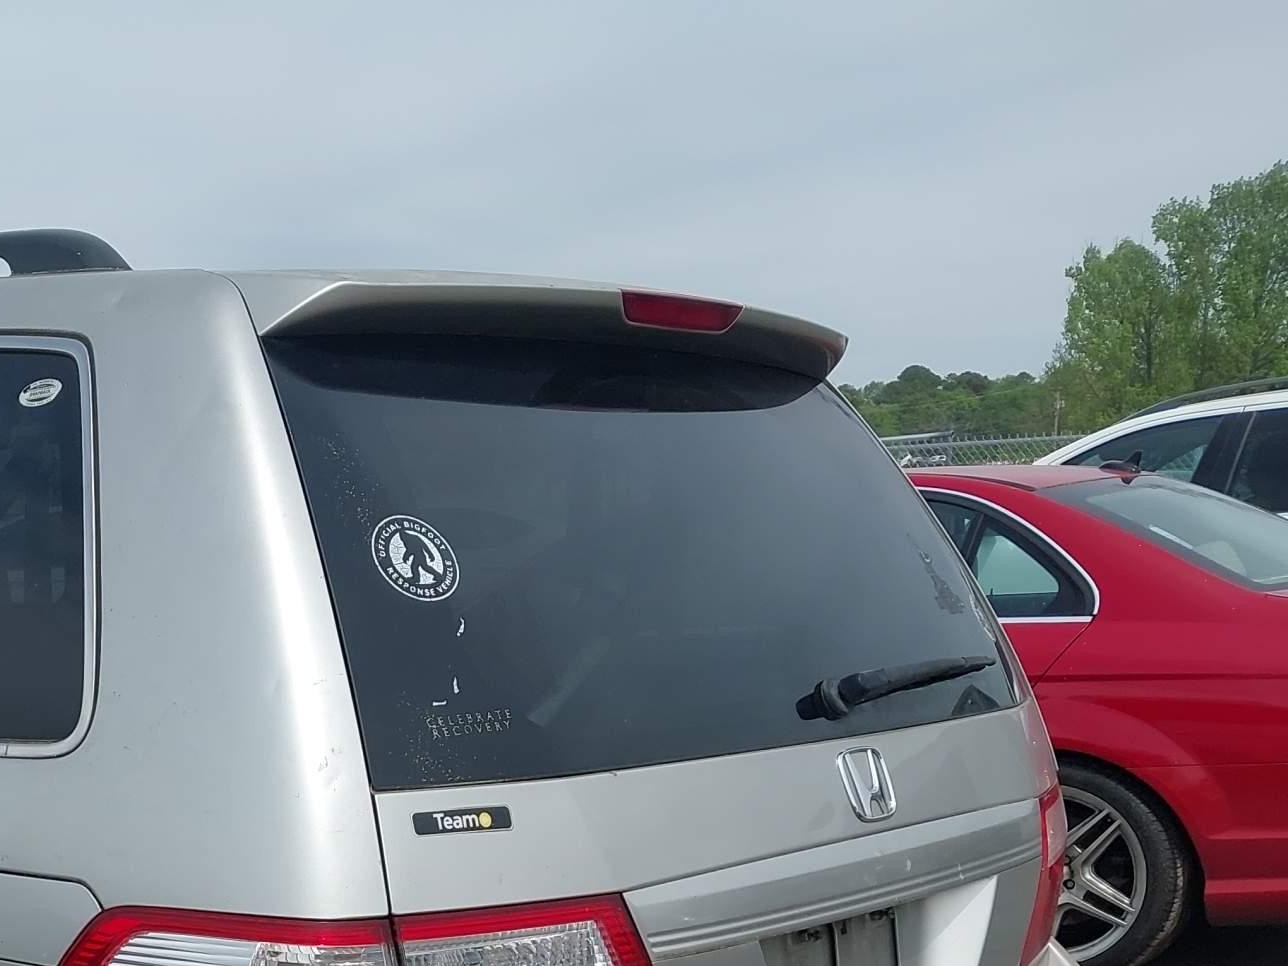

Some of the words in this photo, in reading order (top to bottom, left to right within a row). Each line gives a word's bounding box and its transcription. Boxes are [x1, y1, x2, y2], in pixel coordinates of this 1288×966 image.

[378, 521, 402, 558] OFFICIAL
[403, 521, 447, 550] BIGFOOT
[386, 566, 437, 597] RESPONSE
[436, 559, 454, 593] VEHICLE
[425, 709, 512, 728] CELEBRATE
[432, 720, 510, 740] RECOVERY
